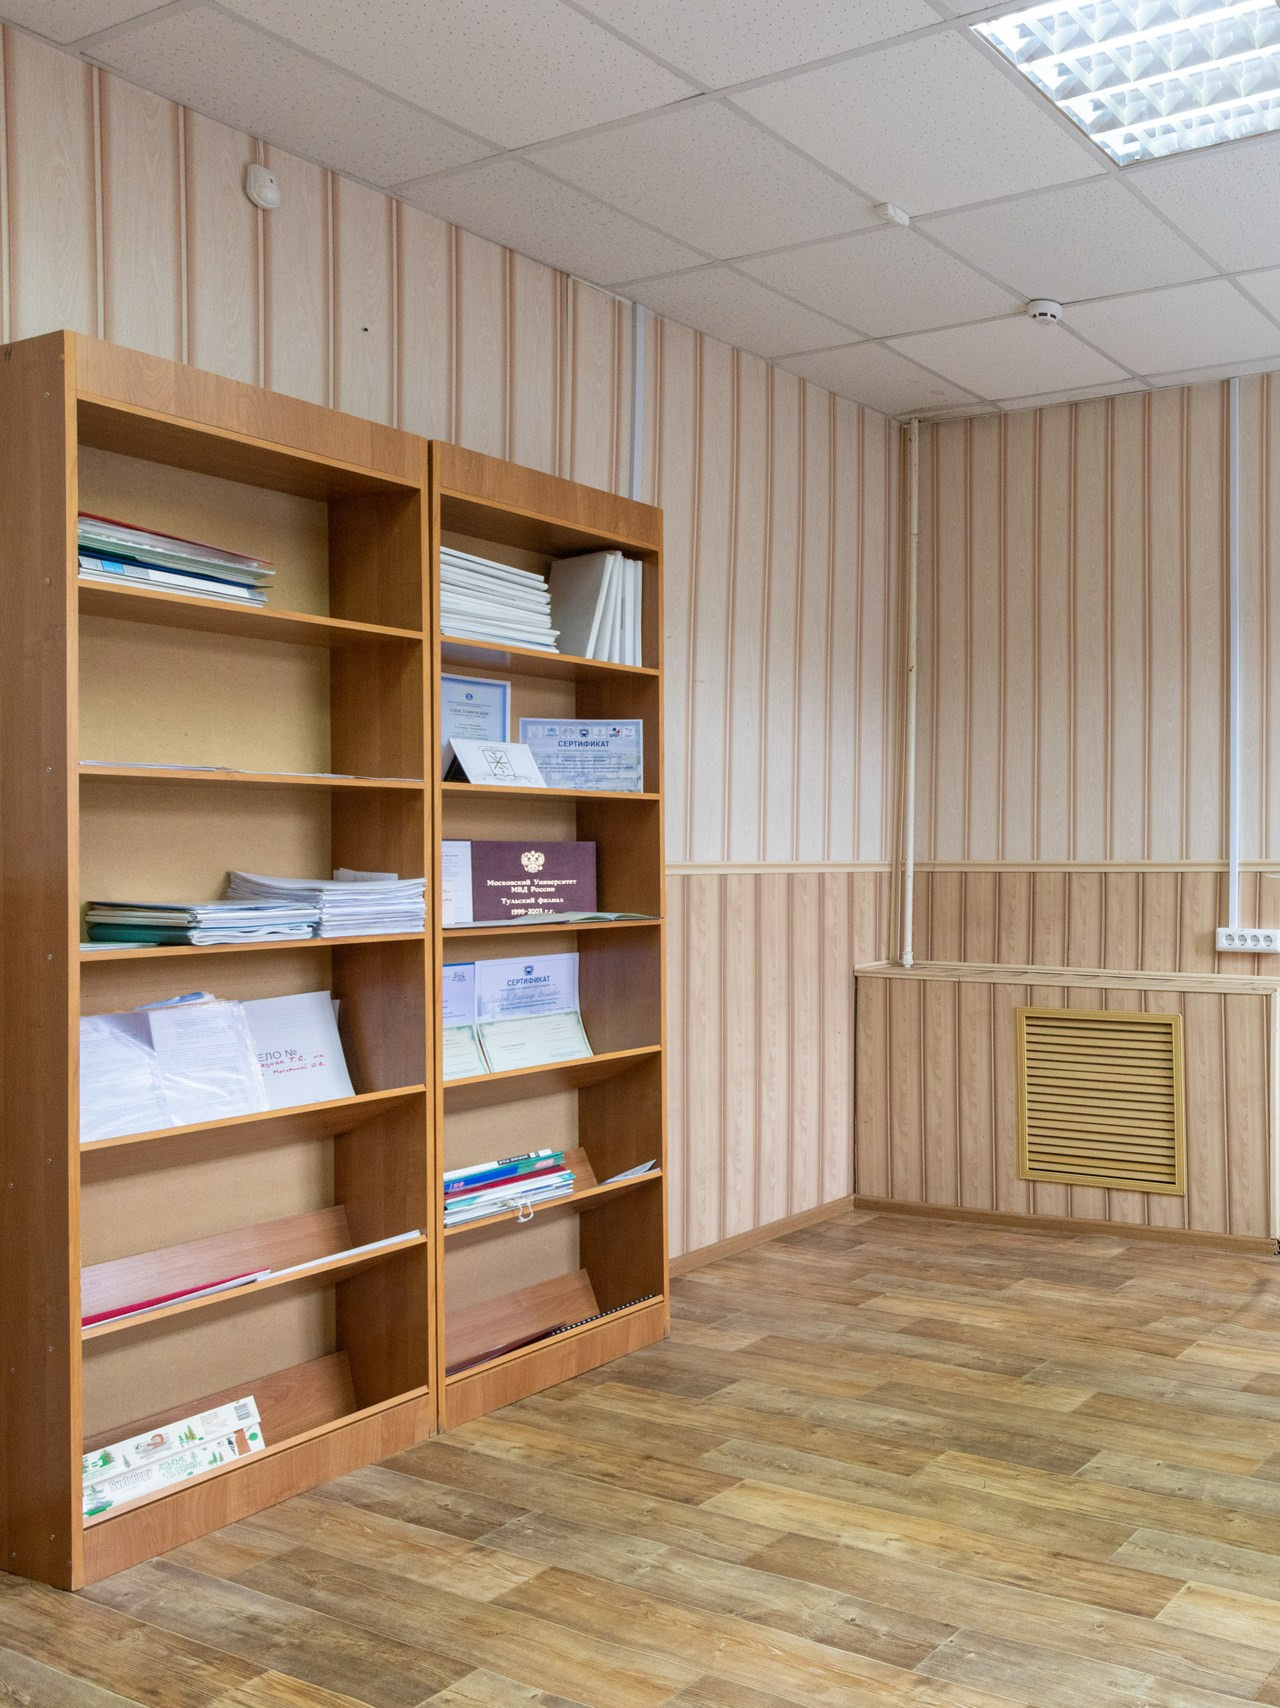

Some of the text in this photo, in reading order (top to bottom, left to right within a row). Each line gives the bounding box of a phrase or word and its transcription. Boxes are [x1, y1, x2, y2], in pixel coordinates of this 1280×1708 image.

[558, 740, 610, 748] СЕРТИФИКАТ
[501, 897, 564, 905] Тульский филиал
[511, 908, 543, 916] 1999-2003
[507, 975, 550, 986] СЕРТИФИКАТ
[257, 1051, 282, 1063] ЕЛО
